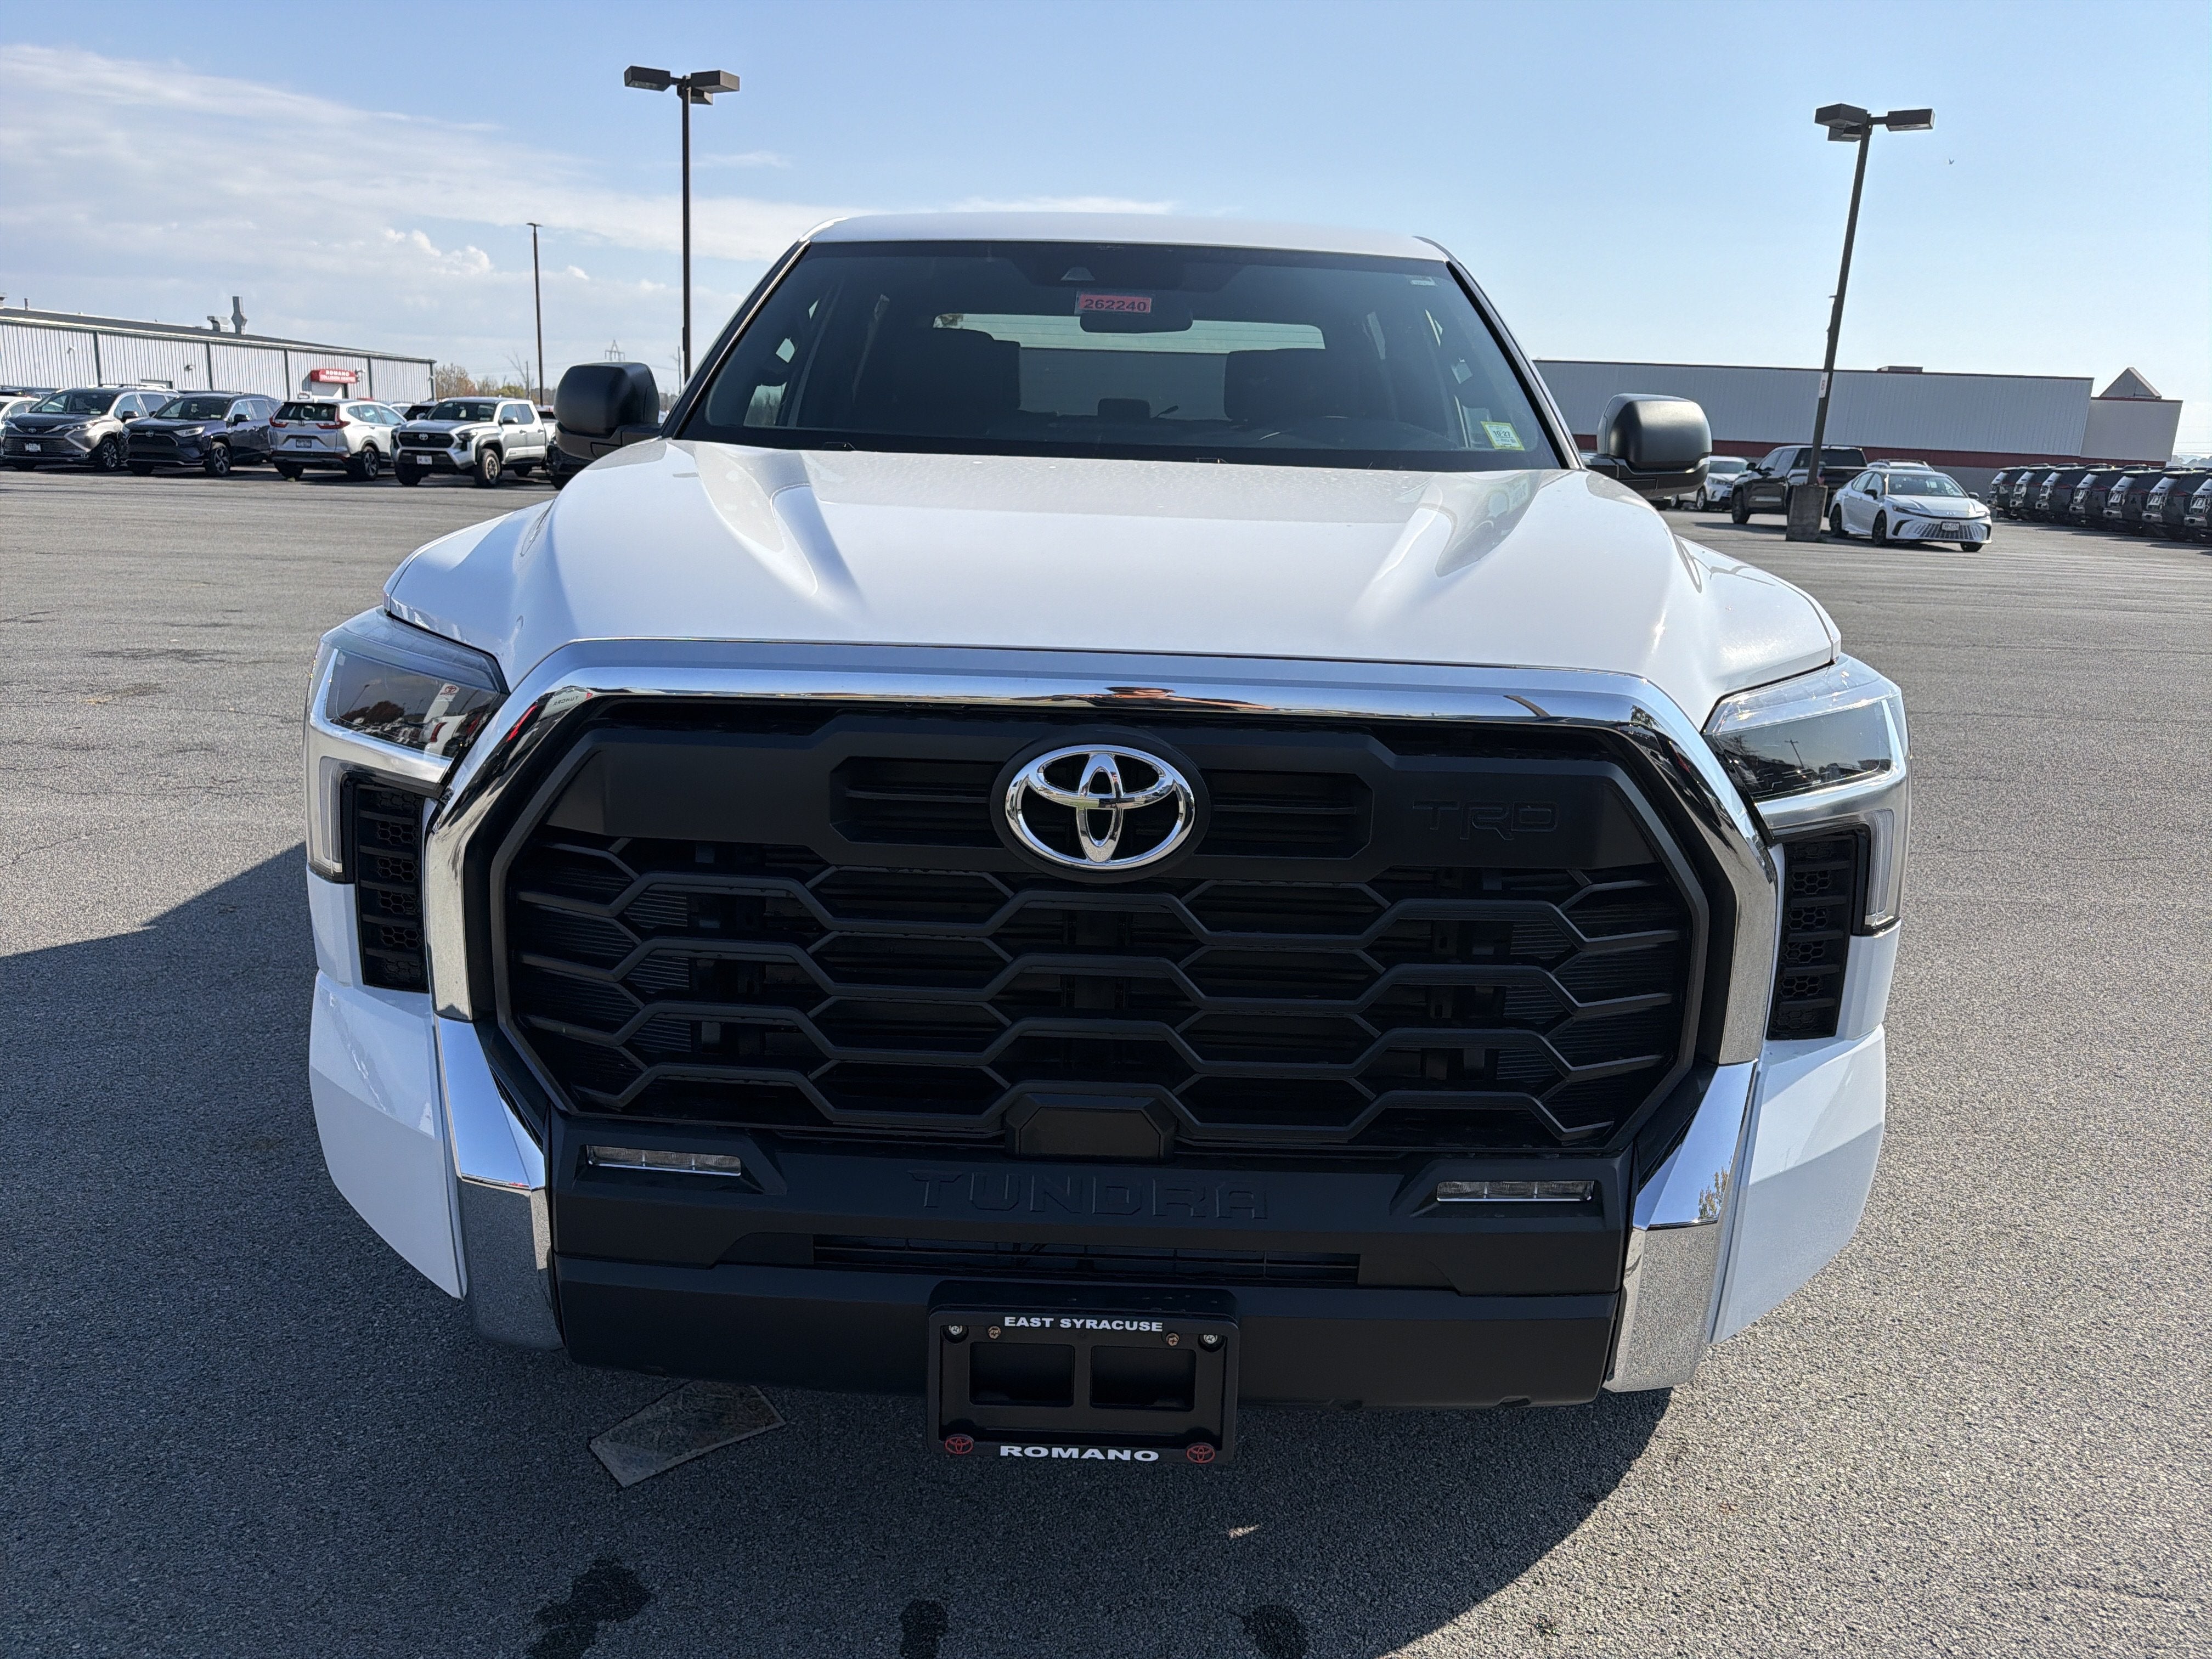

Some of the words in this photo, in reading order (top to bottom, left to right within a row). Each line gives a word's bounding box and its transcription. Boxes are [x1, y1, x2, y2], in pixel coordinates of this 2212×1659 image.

[1084, 298, 1147, 312] 262240
[1412, 800, 1559, 840] TRD
[908, 1170, 1268, 1219] TUNDRA
[1005, 1317, 1054, 1327] EAST
[1060, 1319, 1162, 1331] SYRACUSE
[1001, 1446, 1158, 1461] ROMANO
